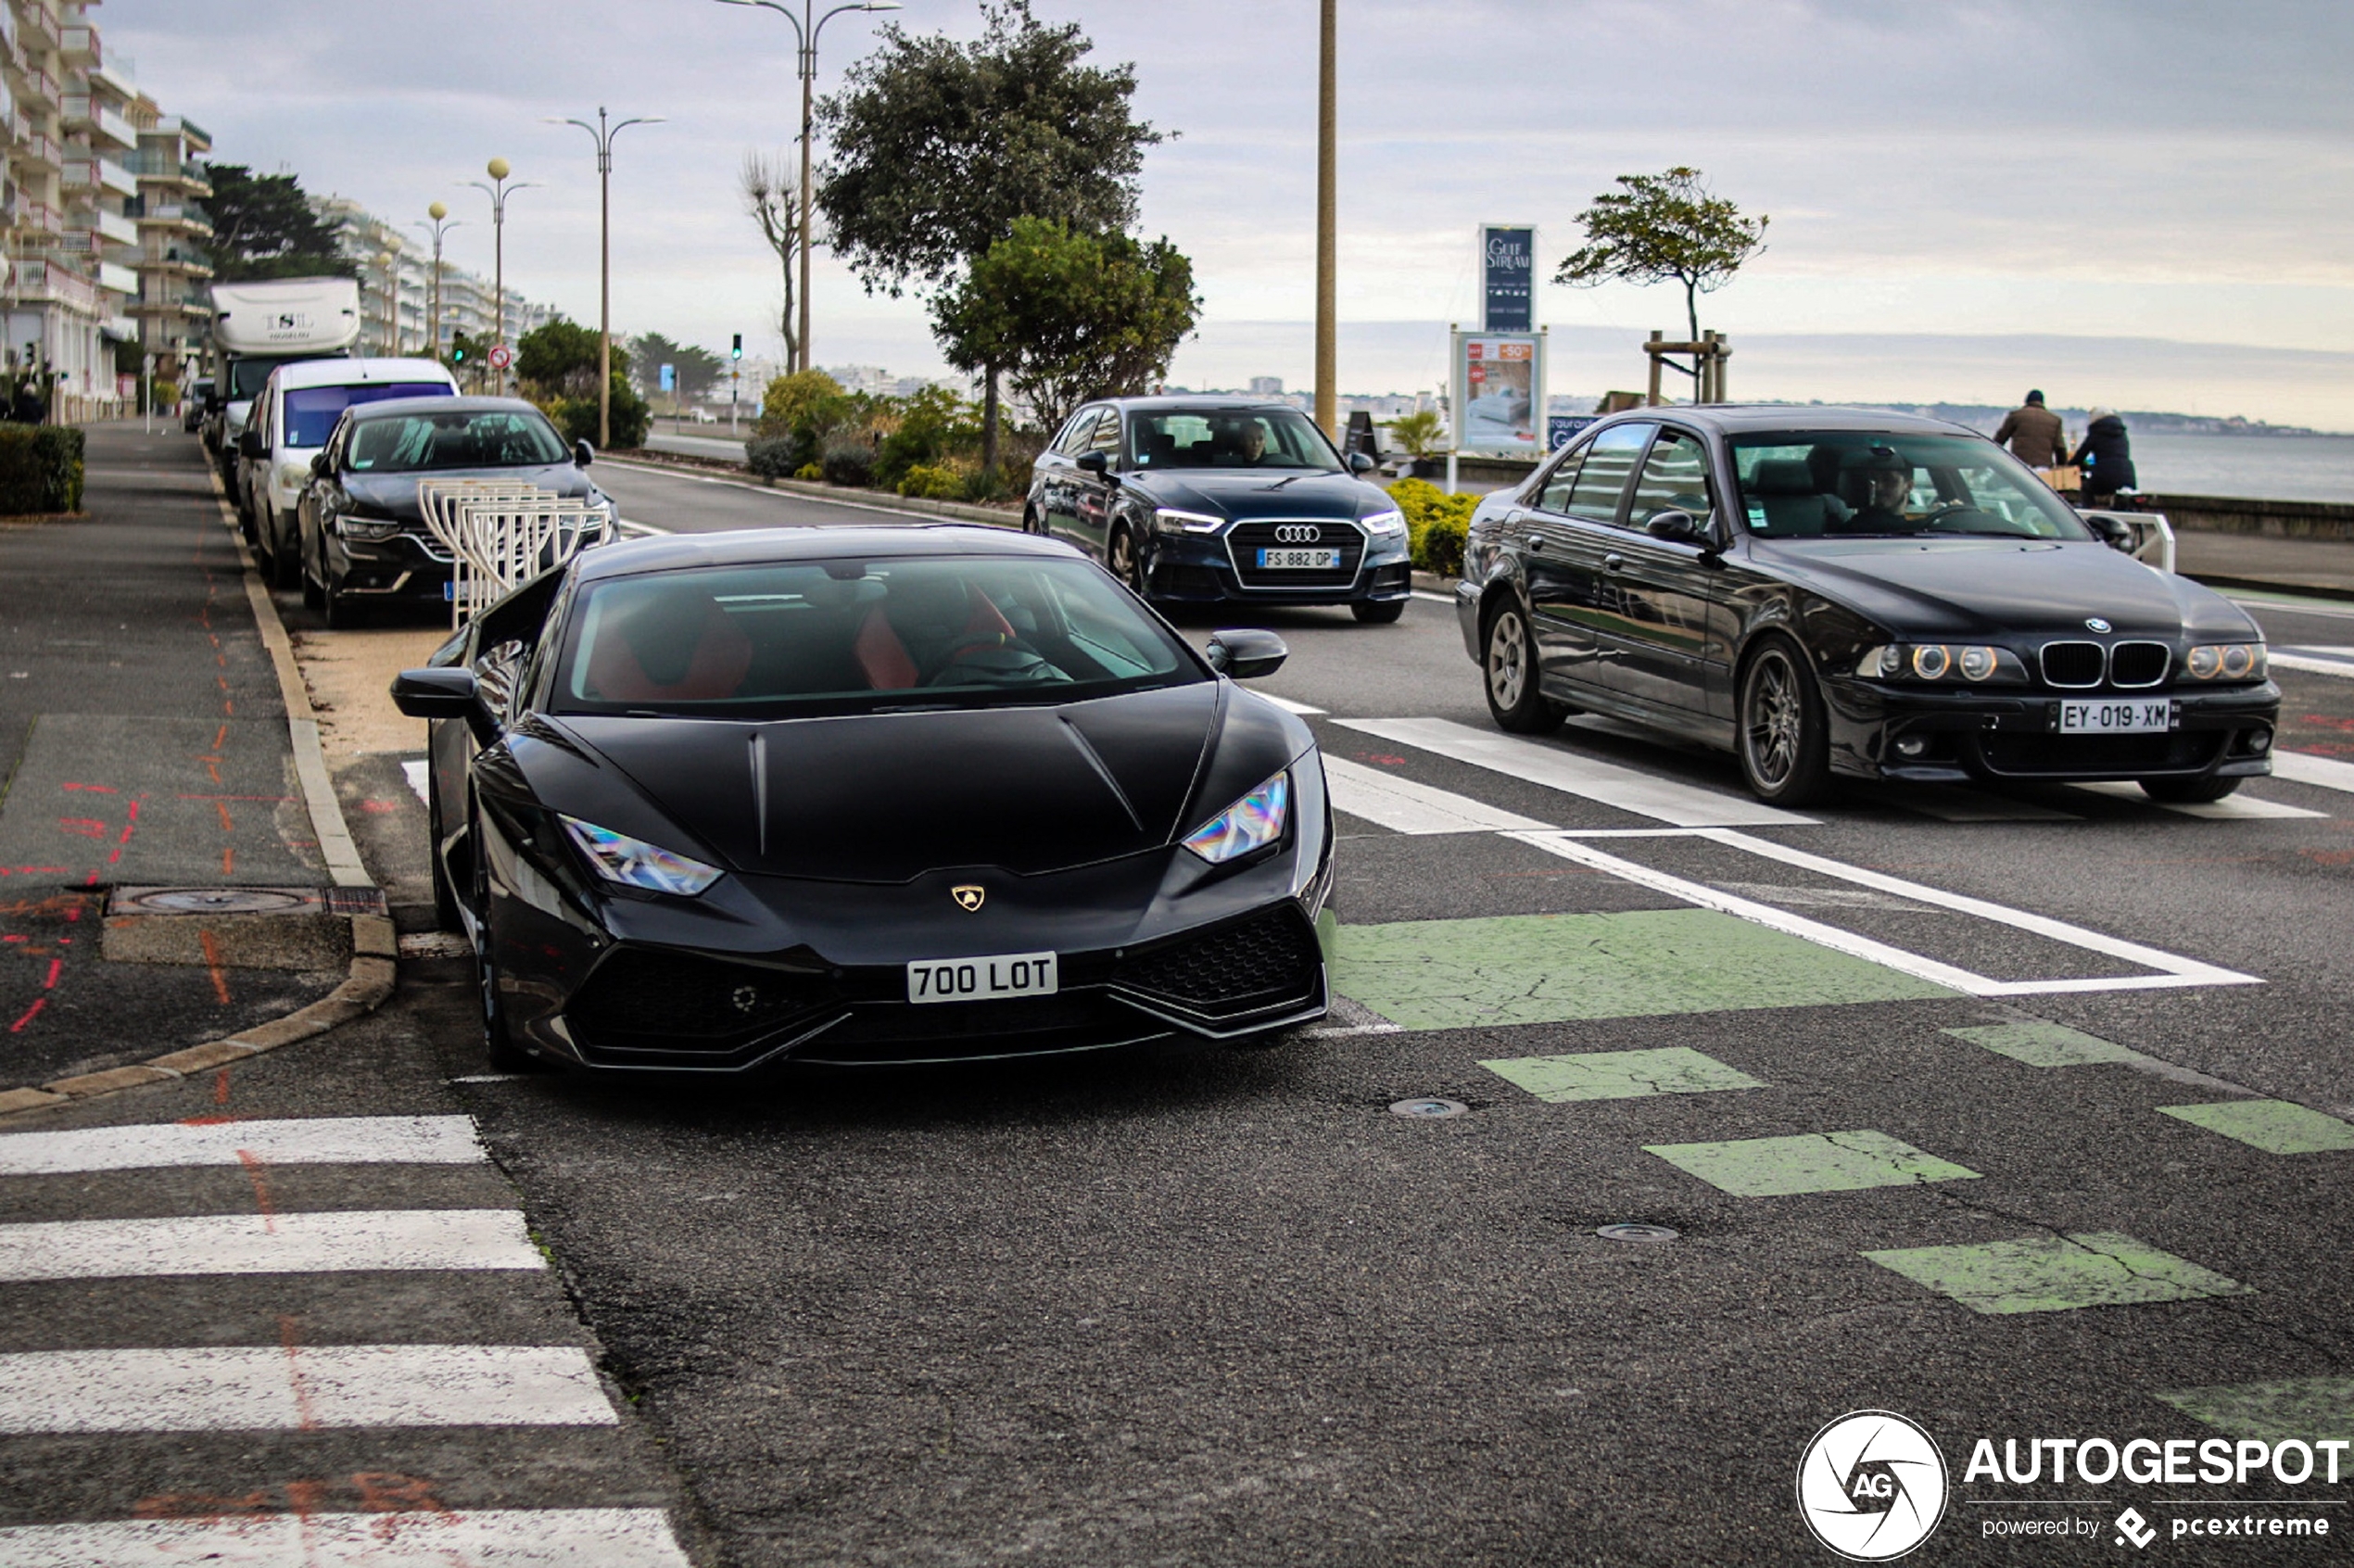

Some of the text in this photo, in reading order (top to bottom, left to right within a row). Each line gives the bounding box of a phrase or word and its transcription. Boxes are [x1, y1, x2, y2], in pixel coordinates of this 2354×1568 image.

[1488, 238, 1521, 256] GULF
[1487, 251, 1530, 271] STREAM
[2064, 704, 2166, 727] EY-019-XM
[913, 959, 1050, 996] 700 LOT
